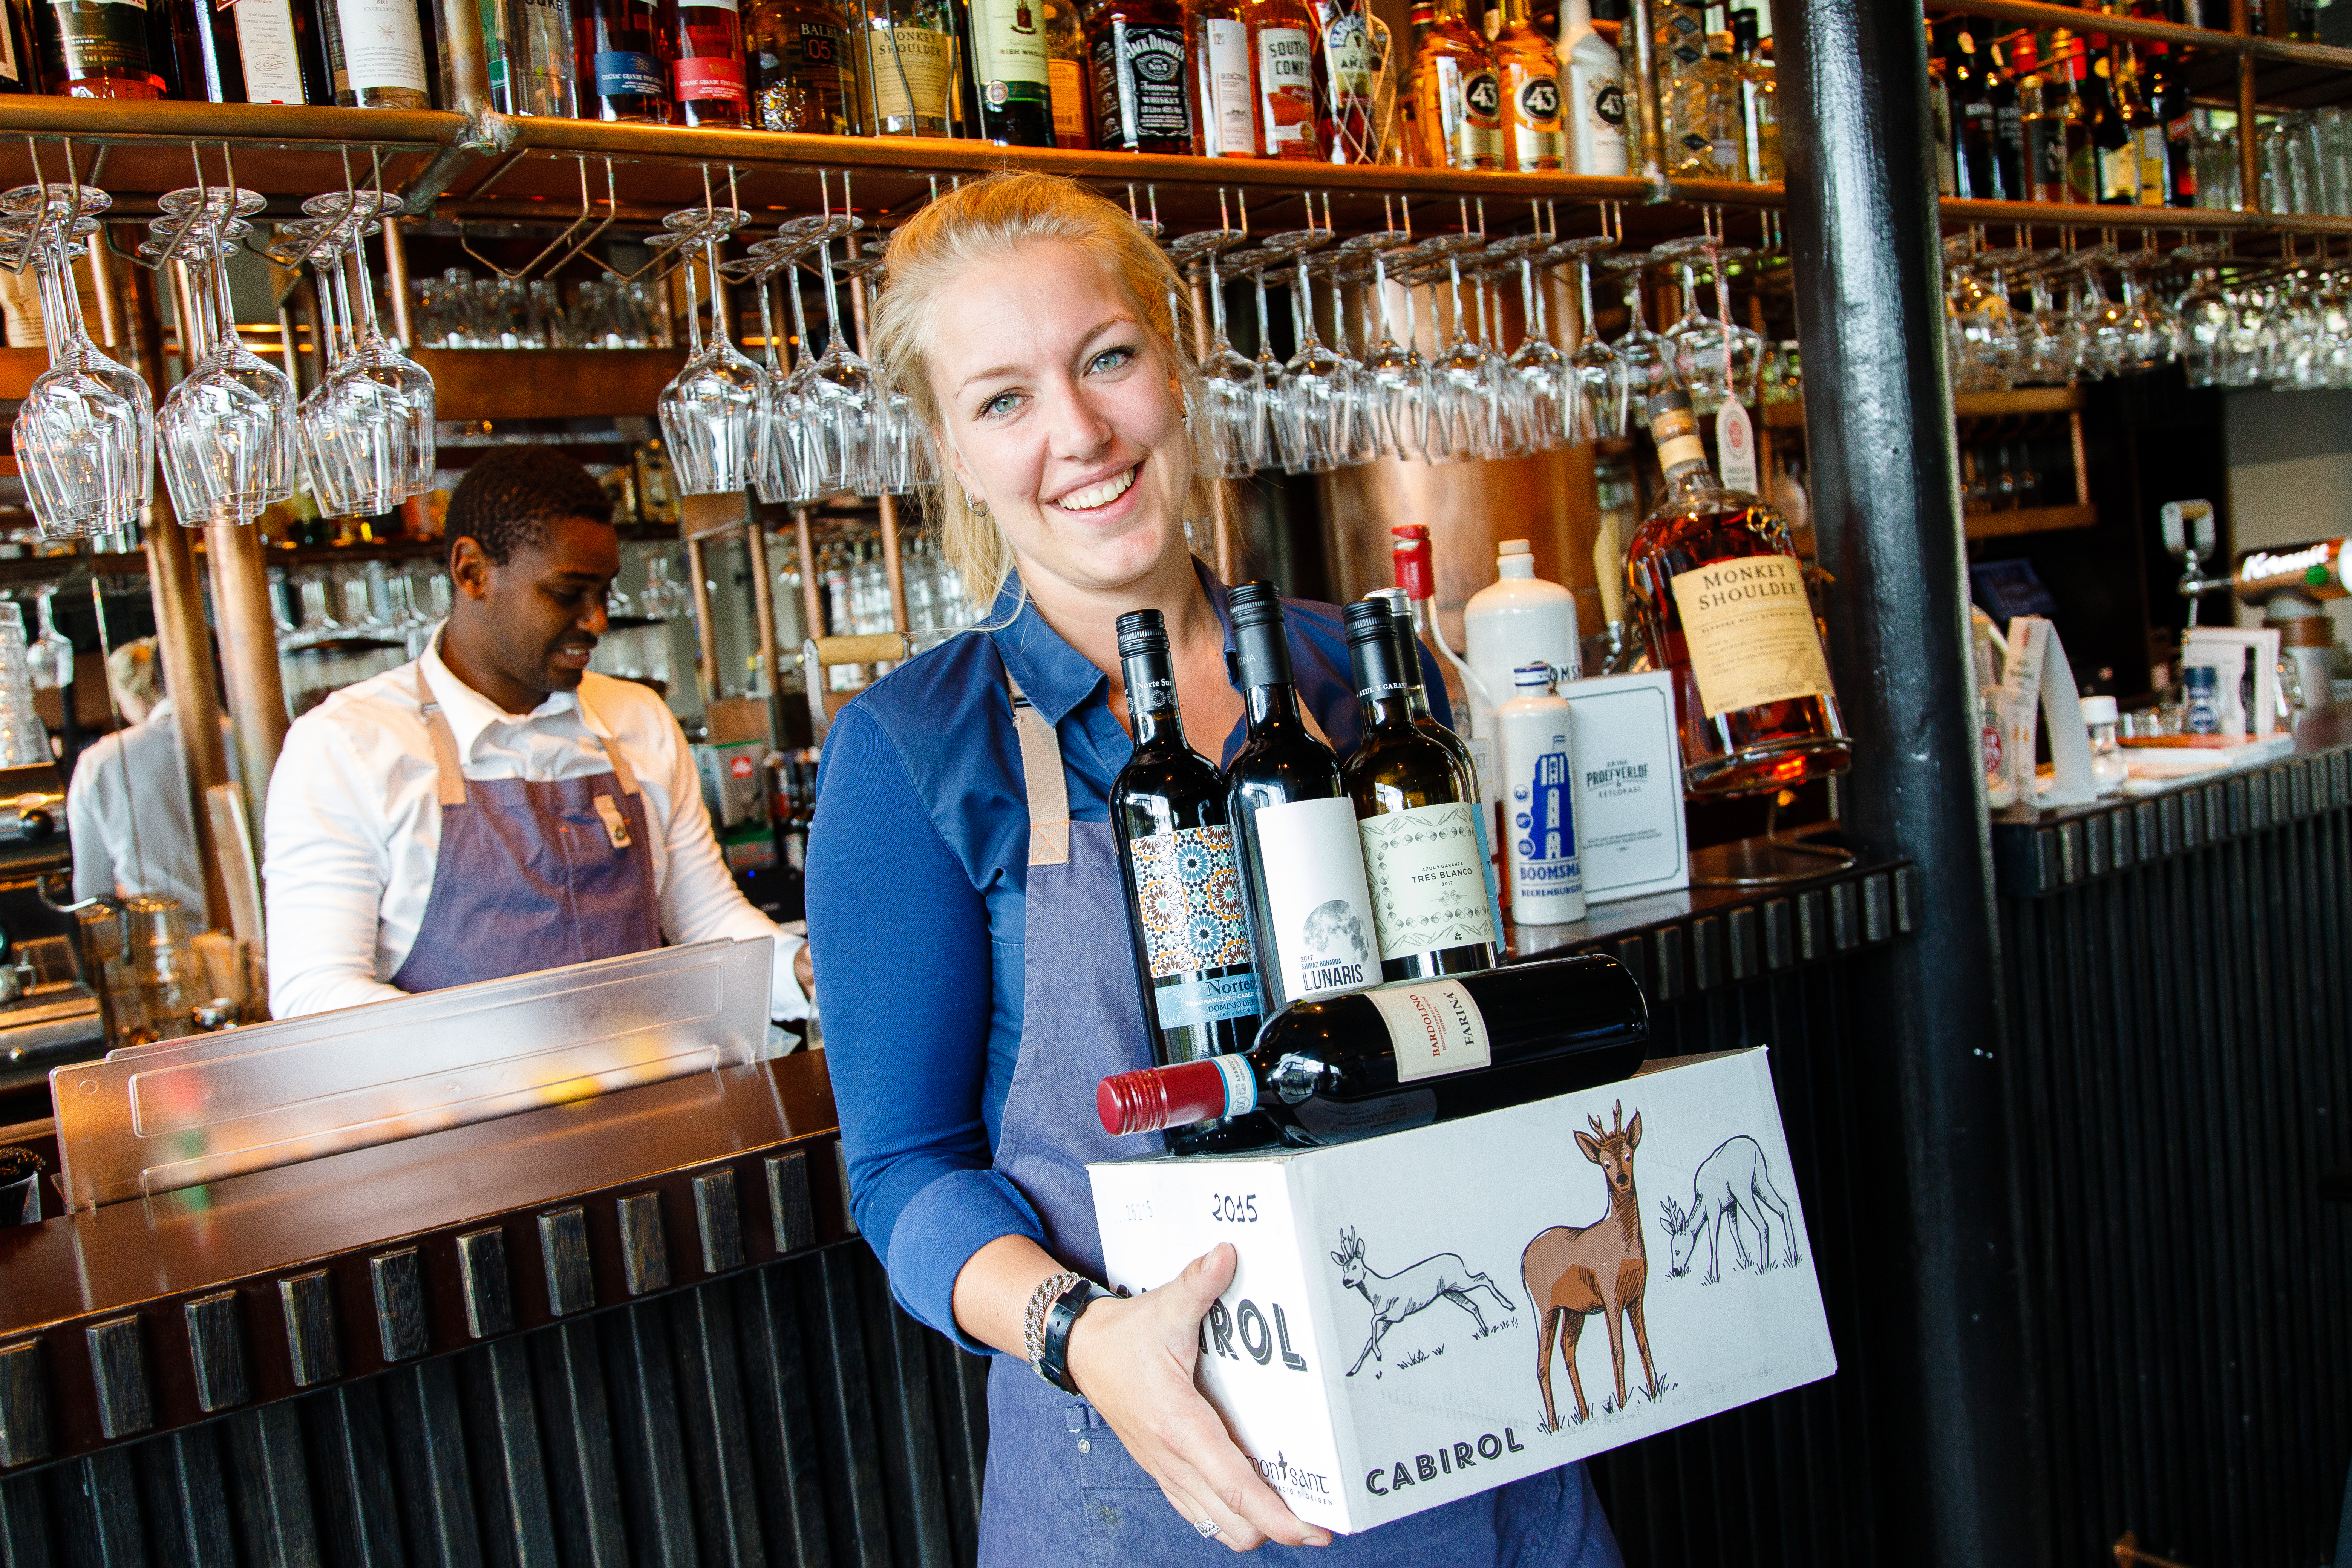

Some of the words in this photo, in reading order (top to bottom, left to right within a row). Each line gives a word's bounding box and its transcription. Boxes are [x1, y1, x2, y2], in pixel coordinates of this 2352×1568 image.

[1125, 38, 1150, 59] JACK
[1148, 34, 1184, 62] DANIEL'S
[1470, 82, 1498, 109] 43
[1526, 86, 1557, 111] 43
[1600, 93, 1622, 116] 43
[1702, 563, 1785, 590] MONKEY
[1698, 582, 1798, 611] SHOULDER
[1136, 680, 1160, 691] Norte
[1161, 678, 1172, 687] Sur
[1359, 687, 1375, 697] AZUL
[1412, 873, 1436, 884] TRES
[1439, 868, 1472, 879] BLANCO
[1302, 961, 1319, 970] SHIRAZ
[1320, 958, 1342, 967] BONARDA
[1303, 963, 1363, 991] LUNARIS
[1185, 995, 1231, 1008] TEMPRANILLO
[1208, 1001, 1242, 1012] DOMINIO
[1410, 994, 1441, 1058] BARDOLINO
[1432, 1013, 1446, 1051] DENOMINAZIONE
[1433, 1006, 1447, 1034] CONTROLLATA
[1446, 991, 1475, 1046] FARINA
[1212, 1193, 1257, 1222] 2015
[1366, 1427, 1524, 1496] CABIROL
